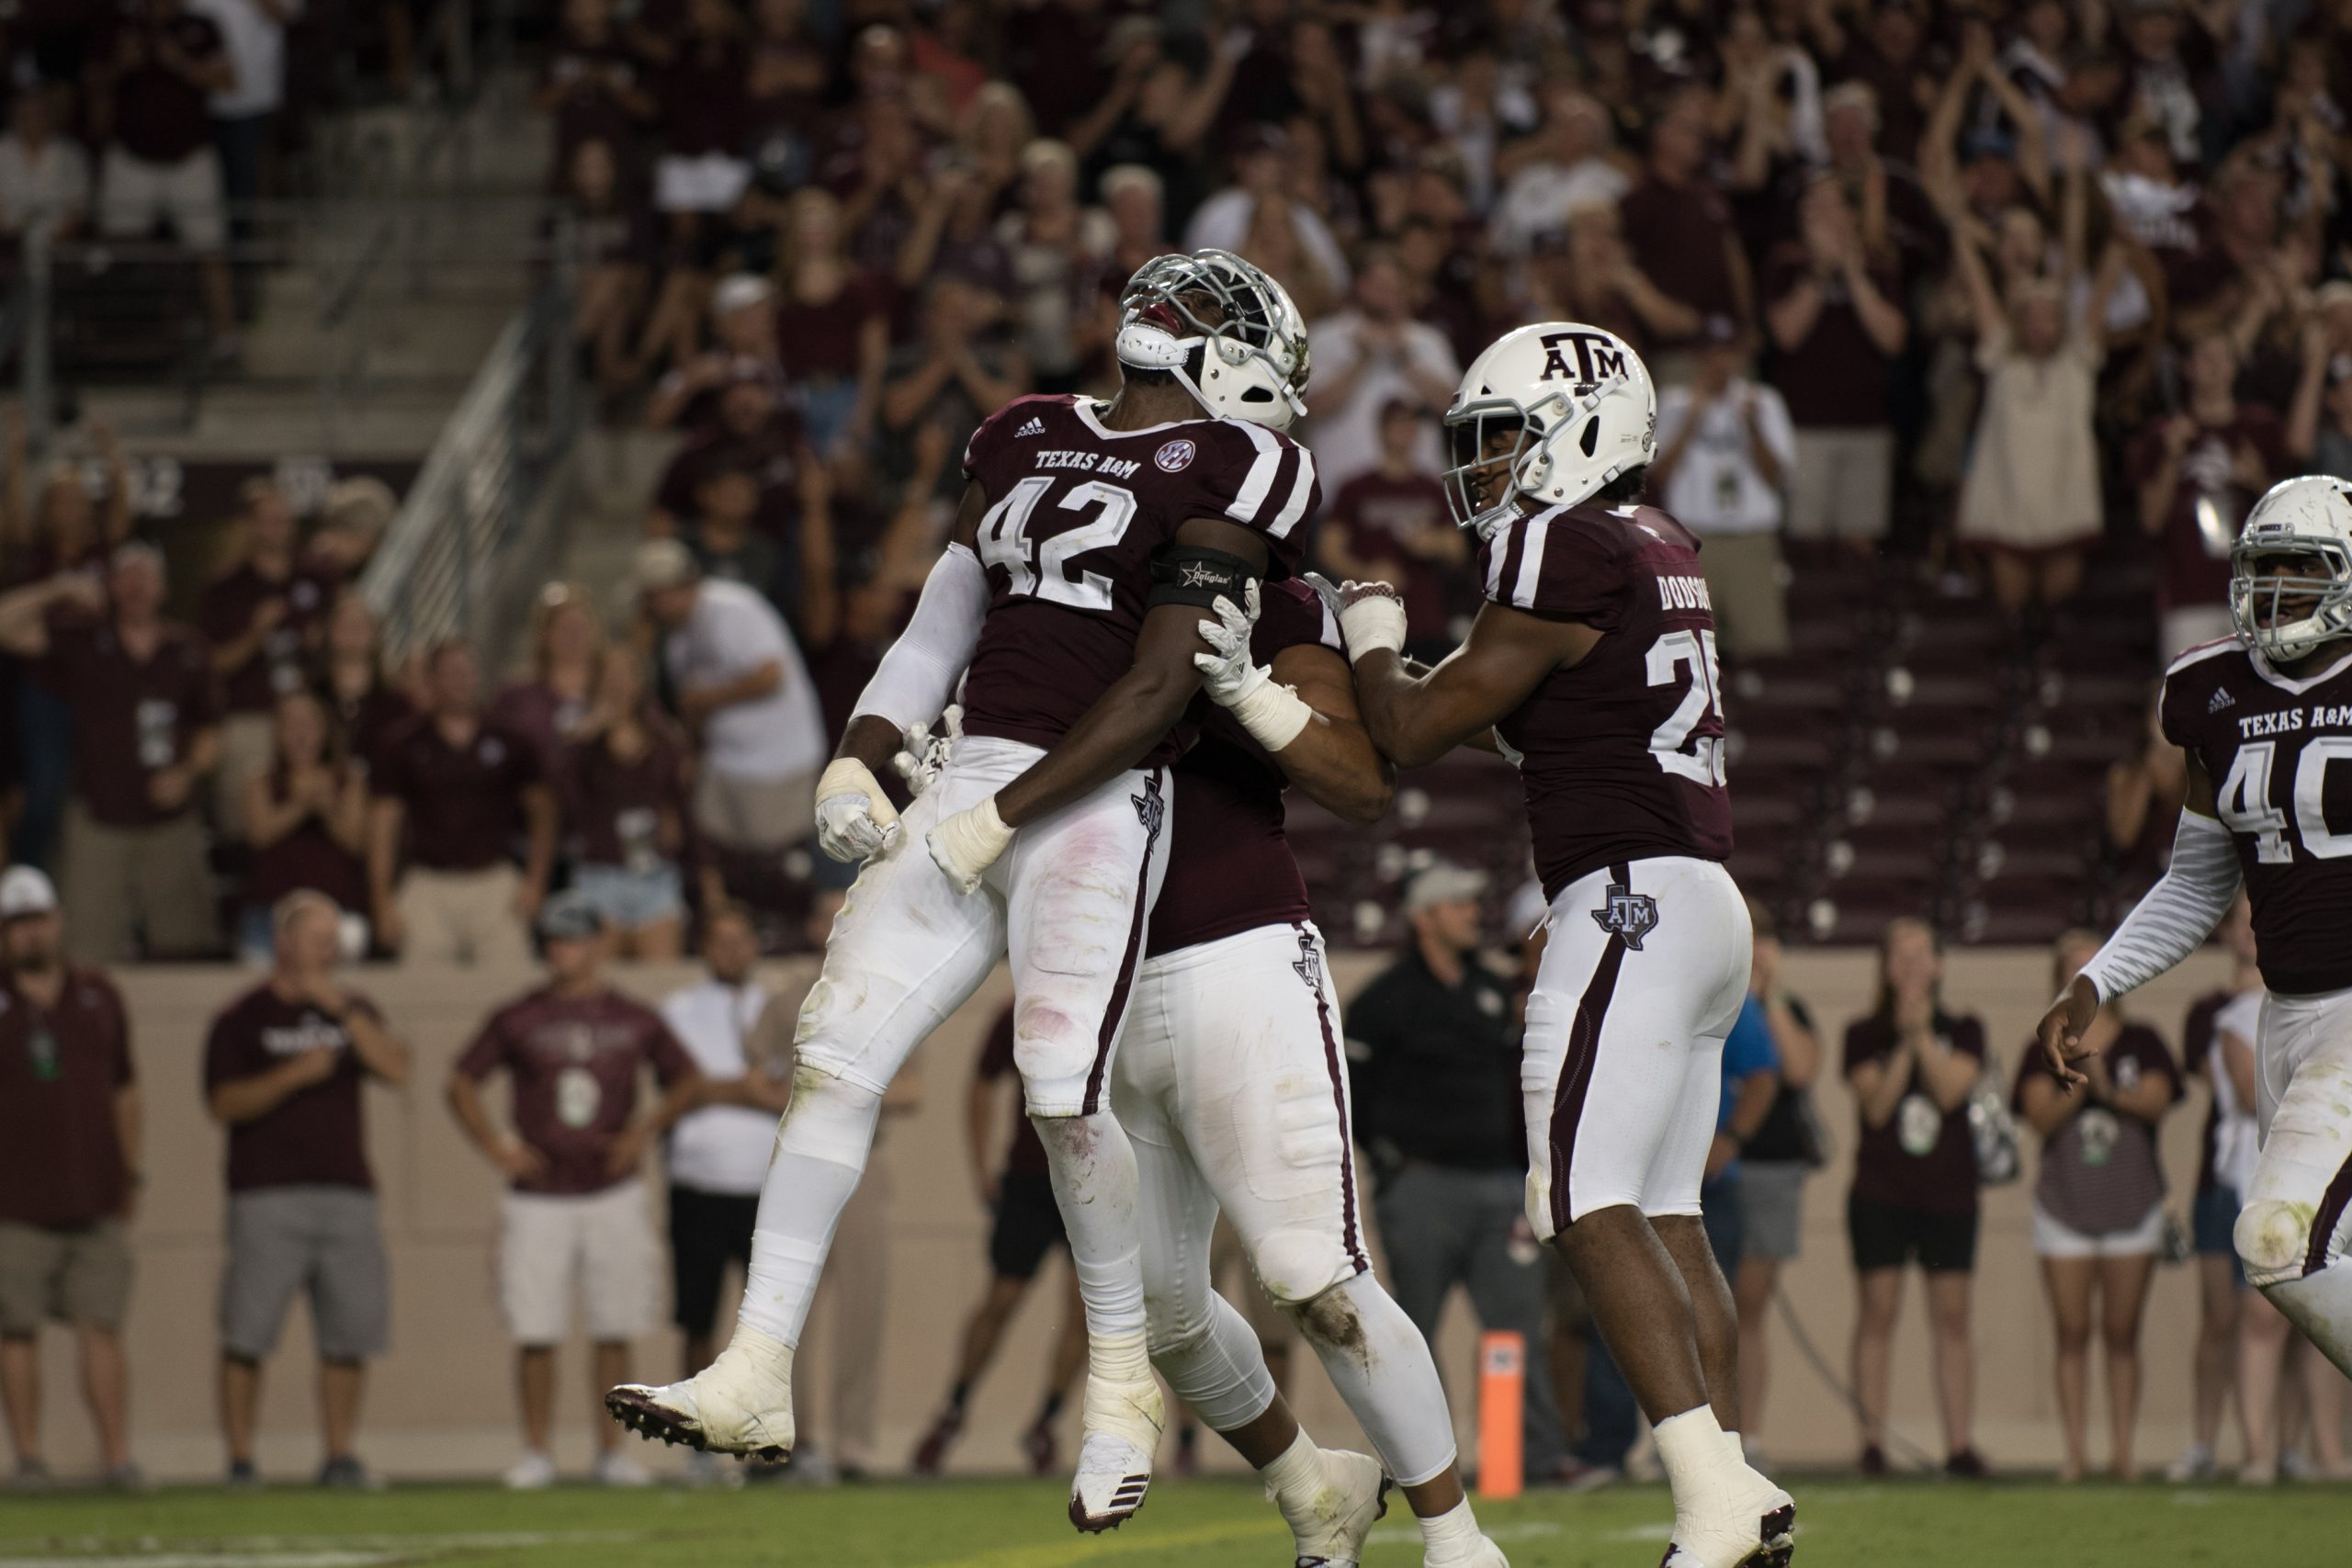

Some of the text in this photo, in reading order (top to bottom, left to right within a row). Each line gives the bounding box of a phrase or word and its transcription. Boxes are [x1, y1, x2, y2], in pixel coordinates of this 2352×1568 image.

[1035, 451, 1141, 480] TEXAS A&M
[1158, 442, 1191, 469] SEC
[977, 476, 1138, 611] 42
[1193, 571, 1228, 584] Douglas
[2238, 705, 2352, 739] TEXAS A&M
[2217, 737, 2352, 863] 40
